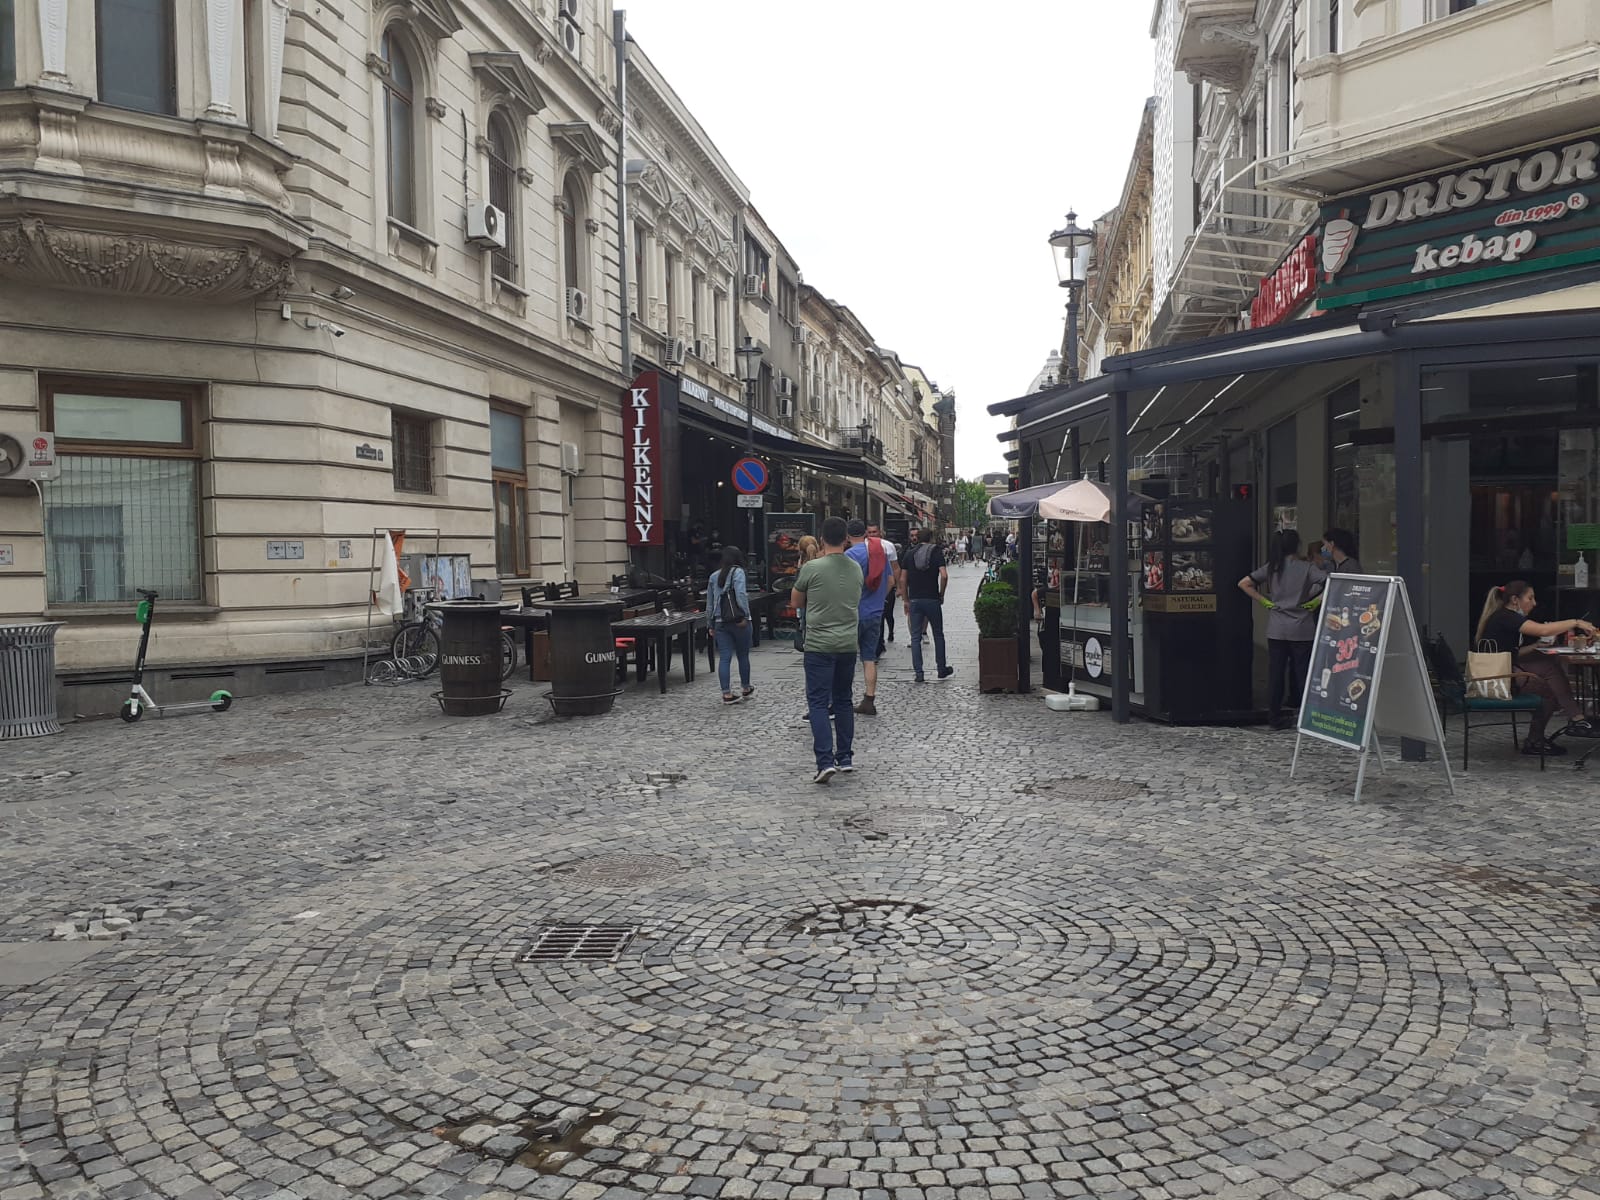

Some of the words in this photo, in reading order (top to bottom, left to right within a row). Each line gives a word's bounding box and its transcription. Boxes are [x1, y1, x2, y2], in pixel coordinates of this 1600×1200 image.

[1362, 140, 1600, 229] DRISTOR
[1495, 209, 1522, 226] din
[1523, 201, 1566, 222] 1999
[1411, 229, 1537, 273] kebap
[630, 387, 654, 542] KILKENNY
[441, 654, 481, 665] GUINNESS
